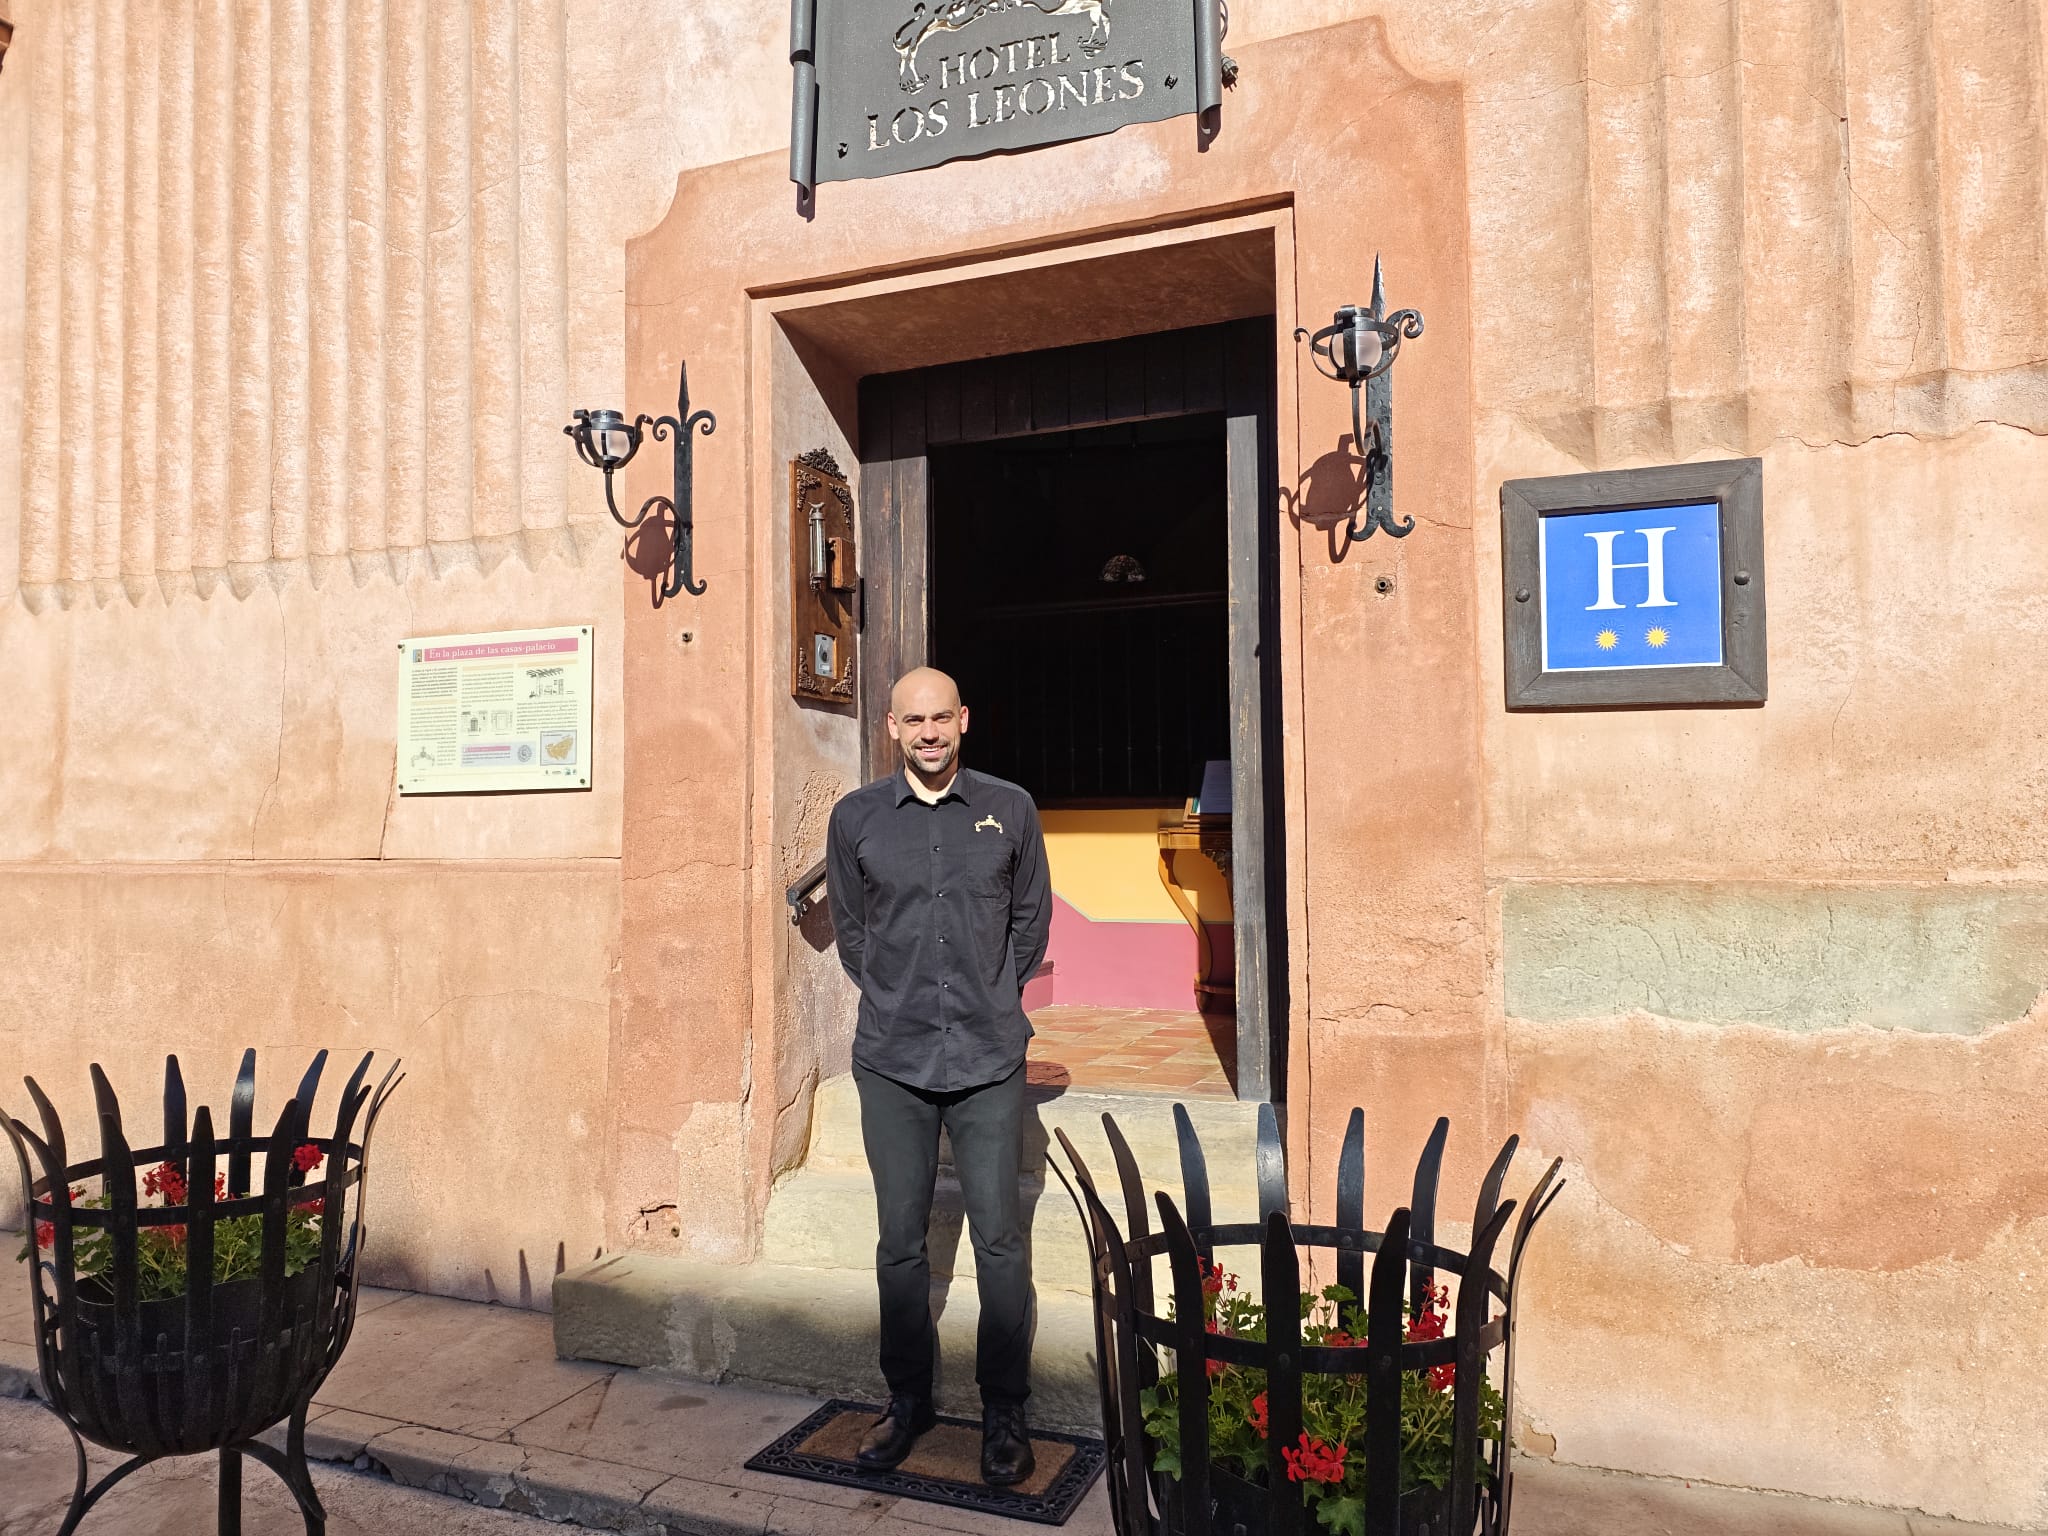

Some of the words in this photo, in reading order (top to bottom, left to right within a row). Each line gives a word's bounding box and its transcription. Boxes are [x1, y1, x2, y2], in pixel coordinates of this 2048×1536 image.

[939, 32, 1071, 89] HOTEL
[867, 99, 949, 151] LOS
[967, 59, 1145, 129] LEONES
[1583, 526, 1679, 611] H
[429, 649, 441, 659] En
[442, 648, 450, 658] la
[452, 648, 473, 660] plaza
[475, 646, 485, 656] de
[487, 645, 499, 655] las
